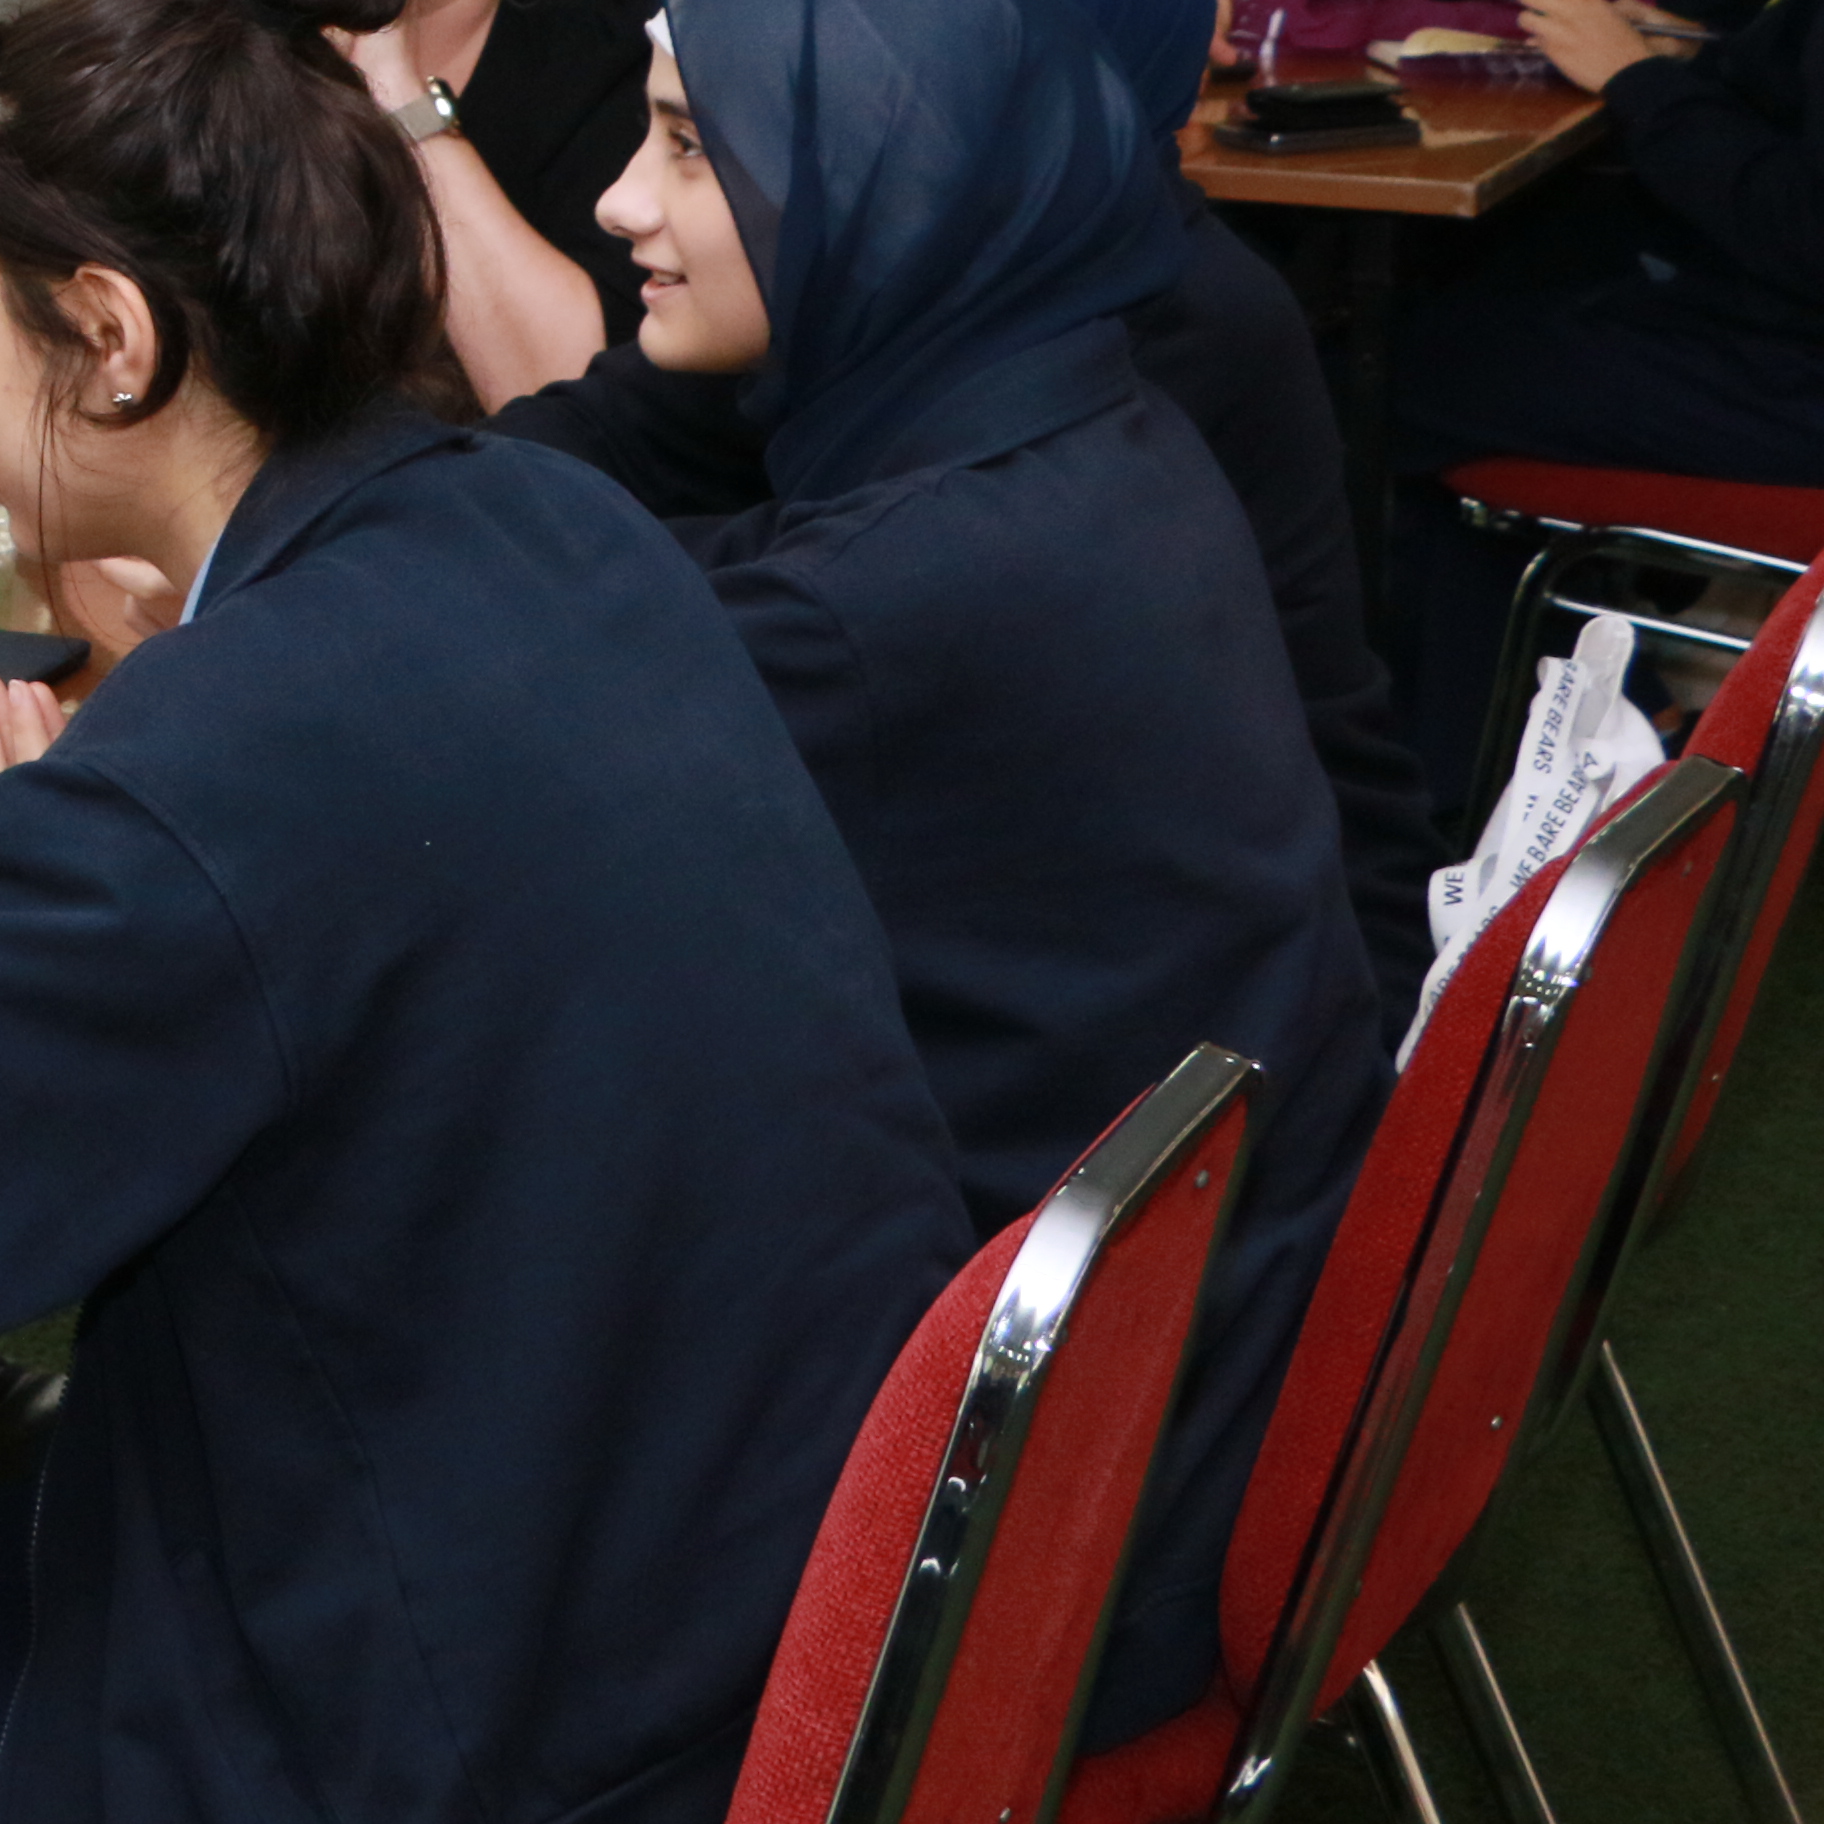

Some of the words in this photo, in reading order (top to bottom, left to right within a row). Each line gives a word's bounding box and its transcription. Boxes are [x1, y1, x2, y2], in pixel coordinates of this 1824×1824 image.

[1534, 708, 1562, 774] BEARS
[1527, 811, 1566, 863] BARE
[1444, 872, 1464, 906] WE
